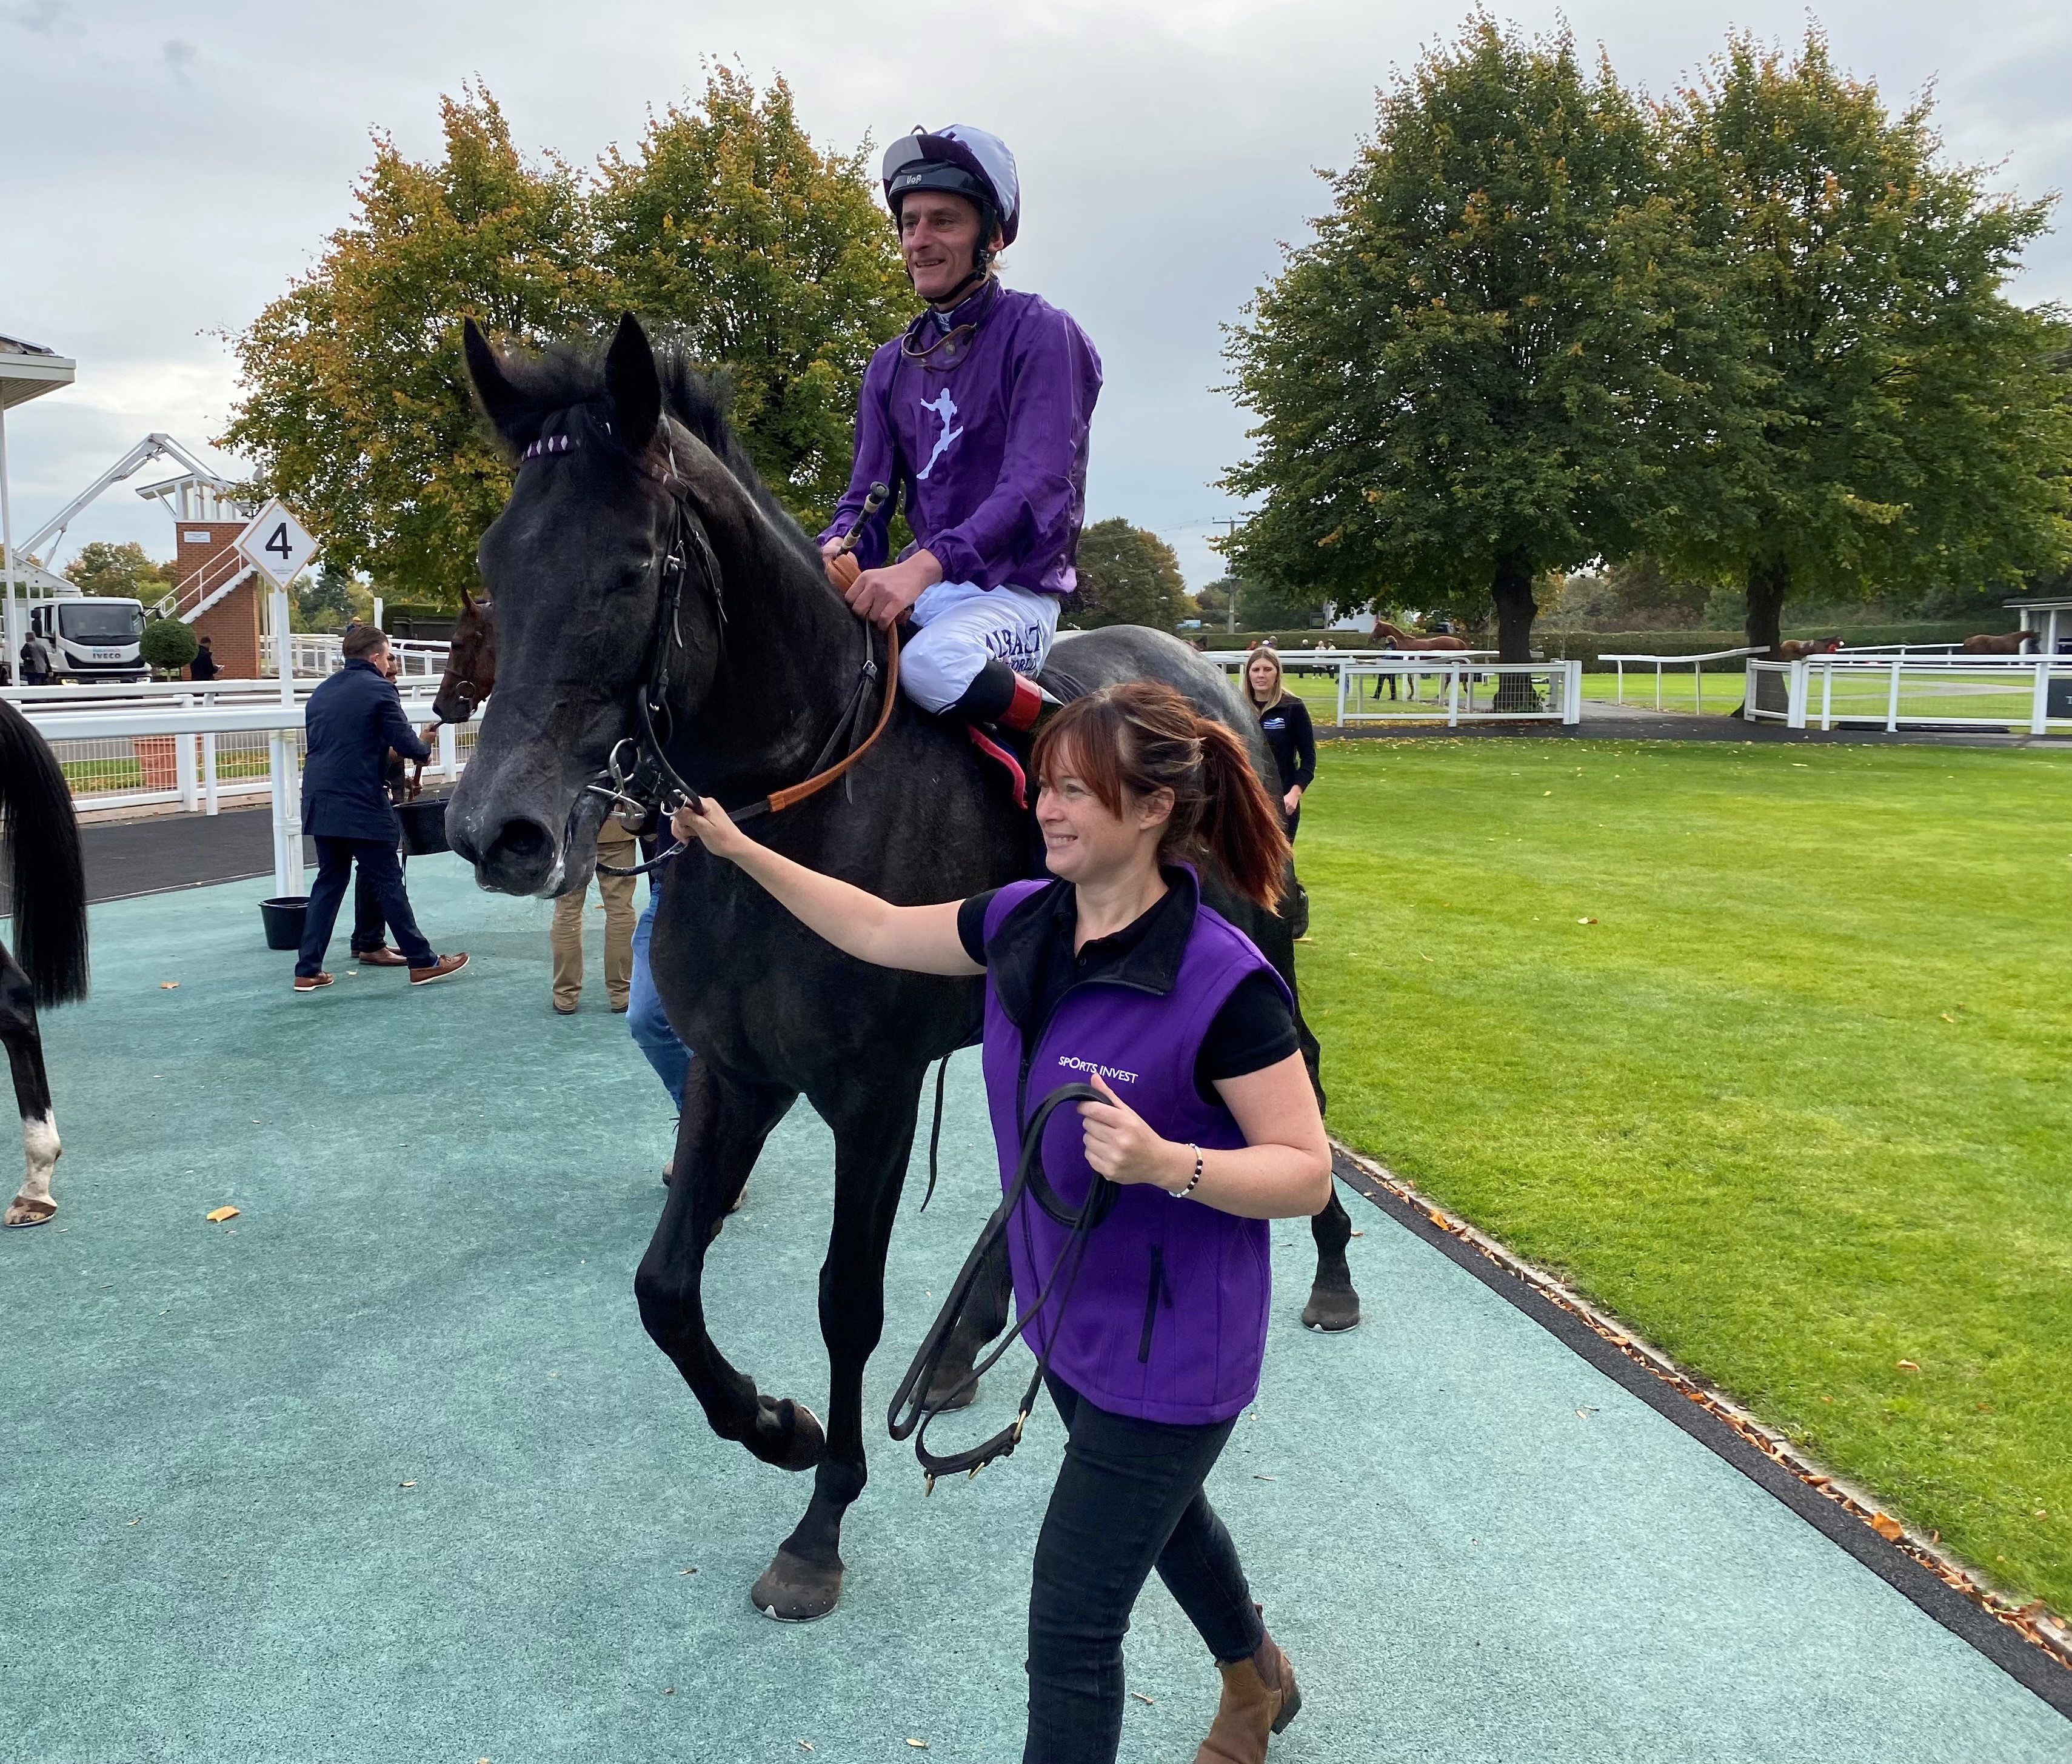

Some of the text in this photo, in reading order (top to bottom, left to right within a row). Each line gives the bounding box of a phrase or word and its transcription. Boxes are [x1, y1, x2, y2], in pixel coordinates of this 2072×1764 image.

[265, 522, 293, 560] 4
[1058, 1056, 1139, 1084] SPORTS INVEST
